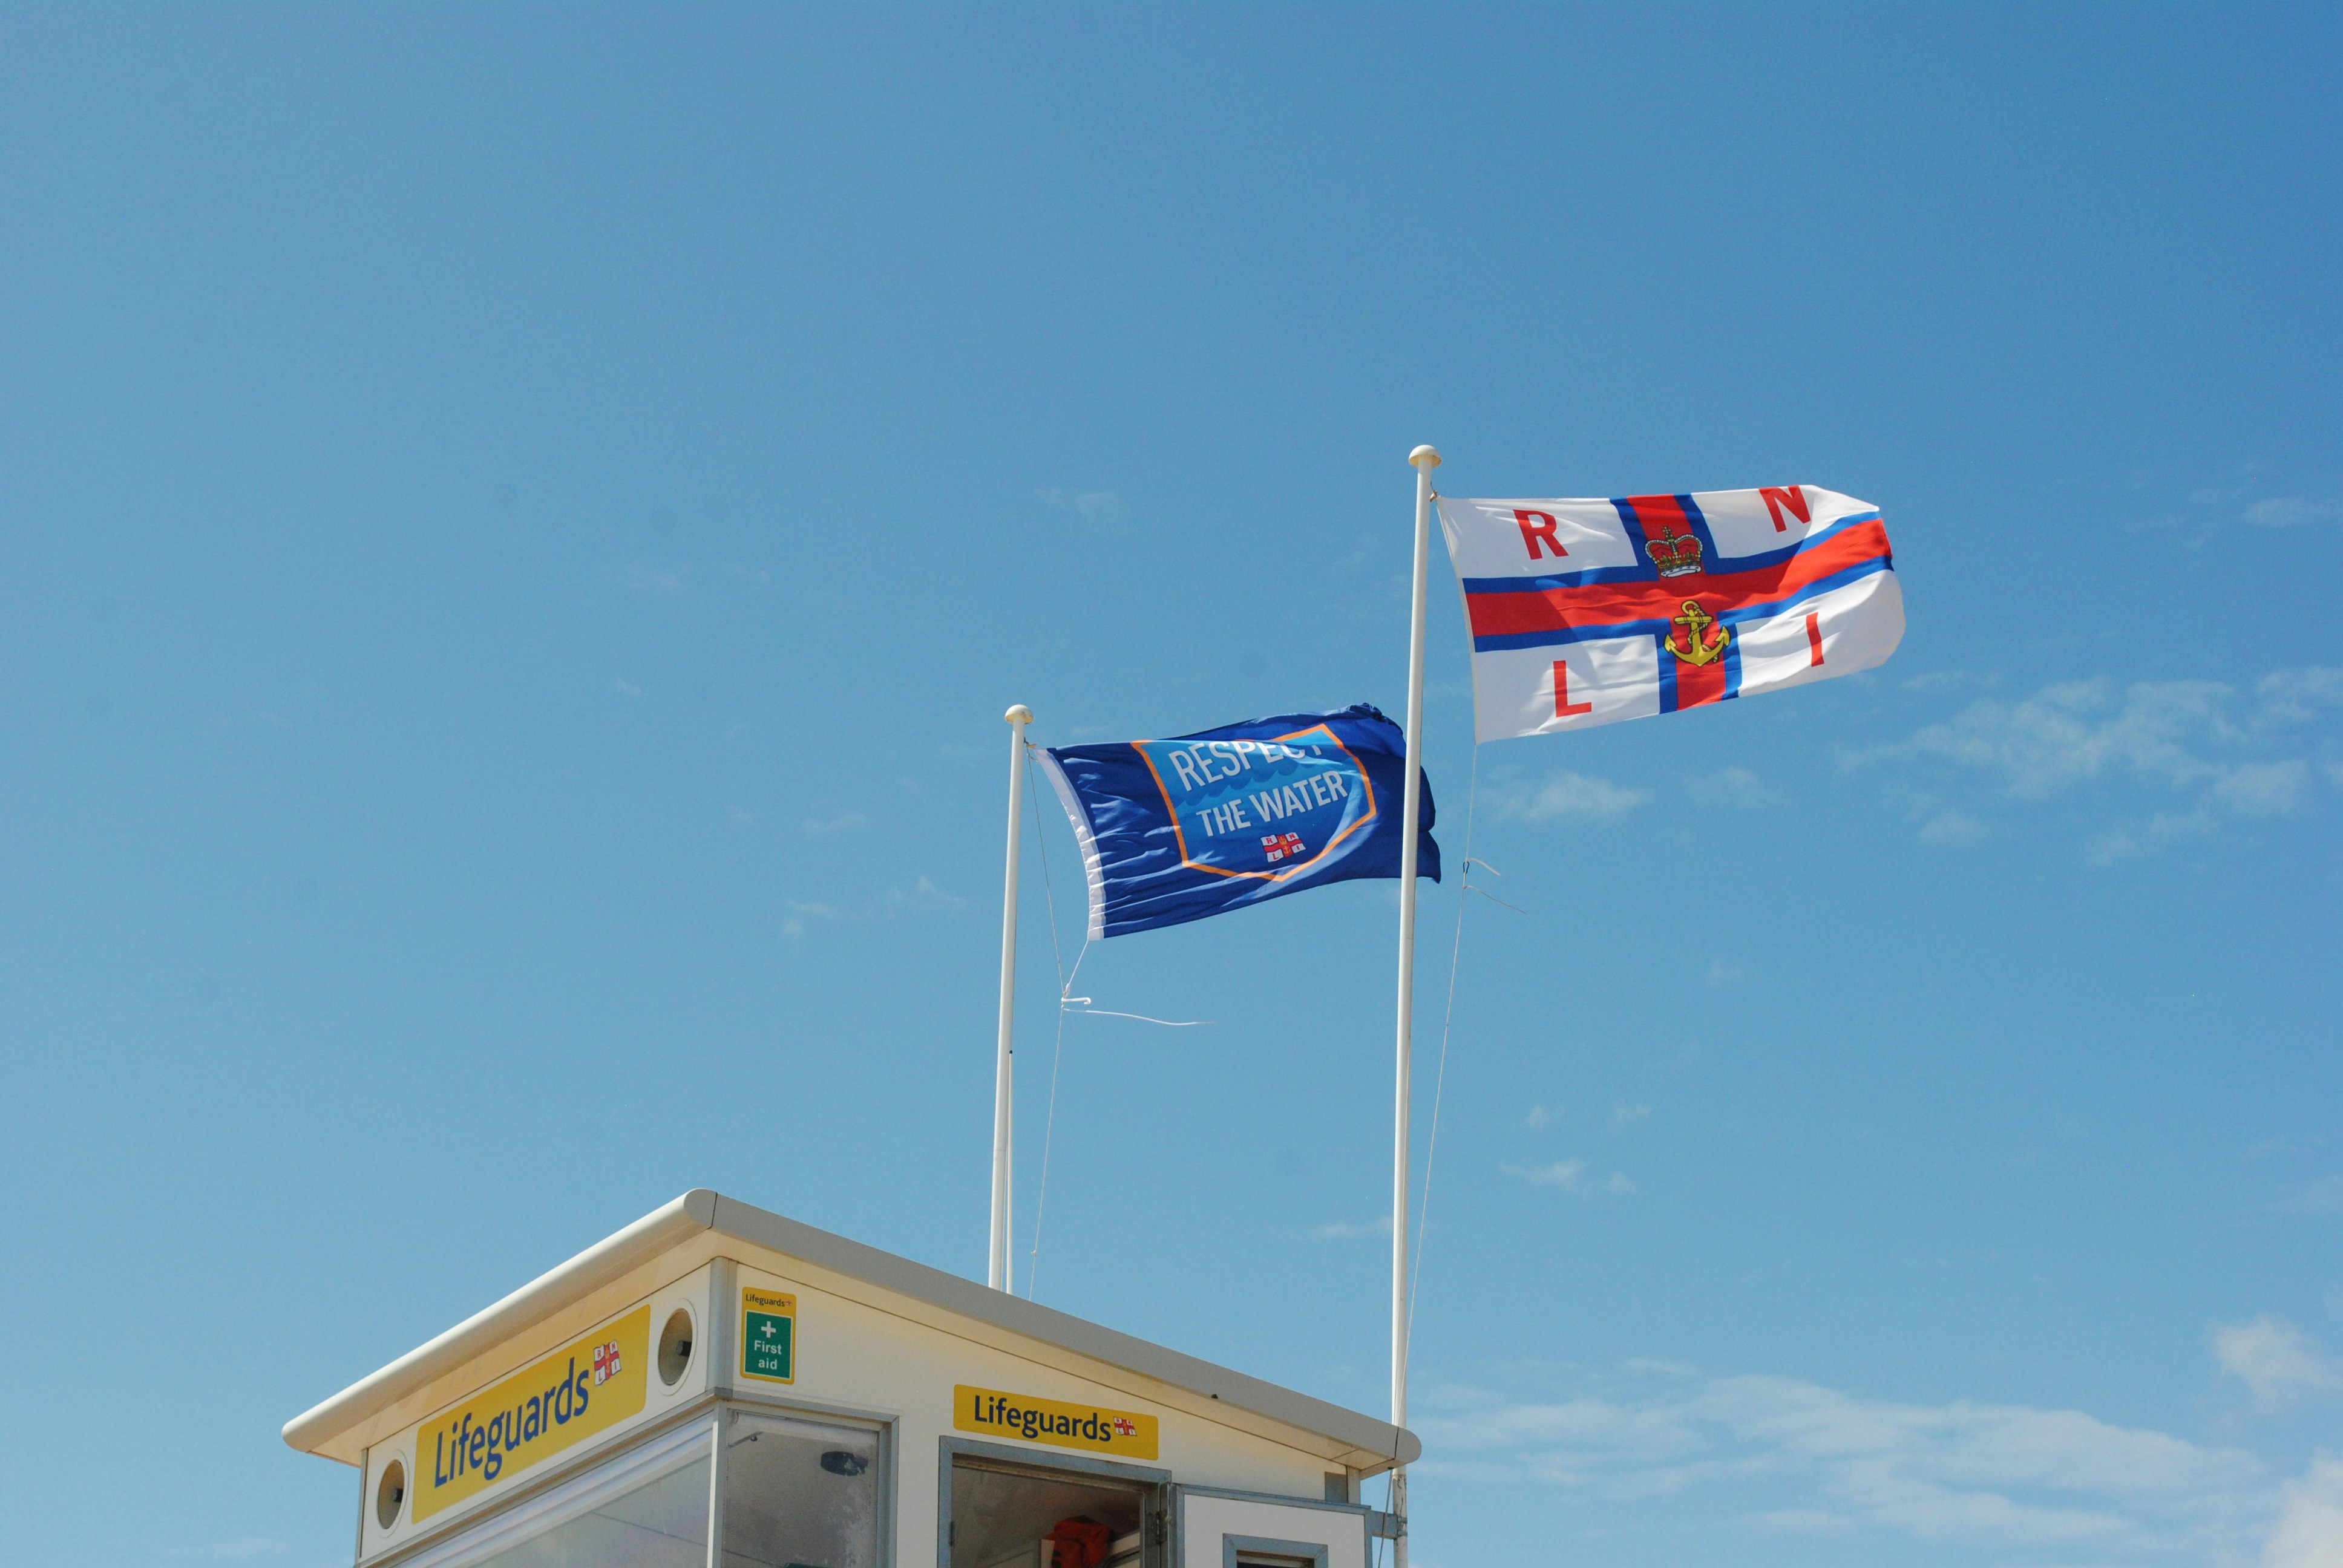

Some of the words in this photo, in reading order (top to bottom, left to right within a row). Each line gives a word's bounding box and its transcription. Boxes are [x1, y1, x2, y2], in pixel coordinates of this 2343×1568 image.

[1513, 509, 1569, 560] R
[1758, 485, 1811, 533] N
[1553, 661, 1592, 717] L
[1806, 612, 1824, 667] I
[1196, 799, 1251, 837] THE
[1249, 771, 1348, 822] WATER
[746, 1293, 785, 1307] Lifeguards
[754, 1340, 782, 1354] First
[758, 1358, 778, 1370] aid
[434, 1357, 589, 1488] Lifeguards
[974, 1394, 1112, 1442] Lifeguards
